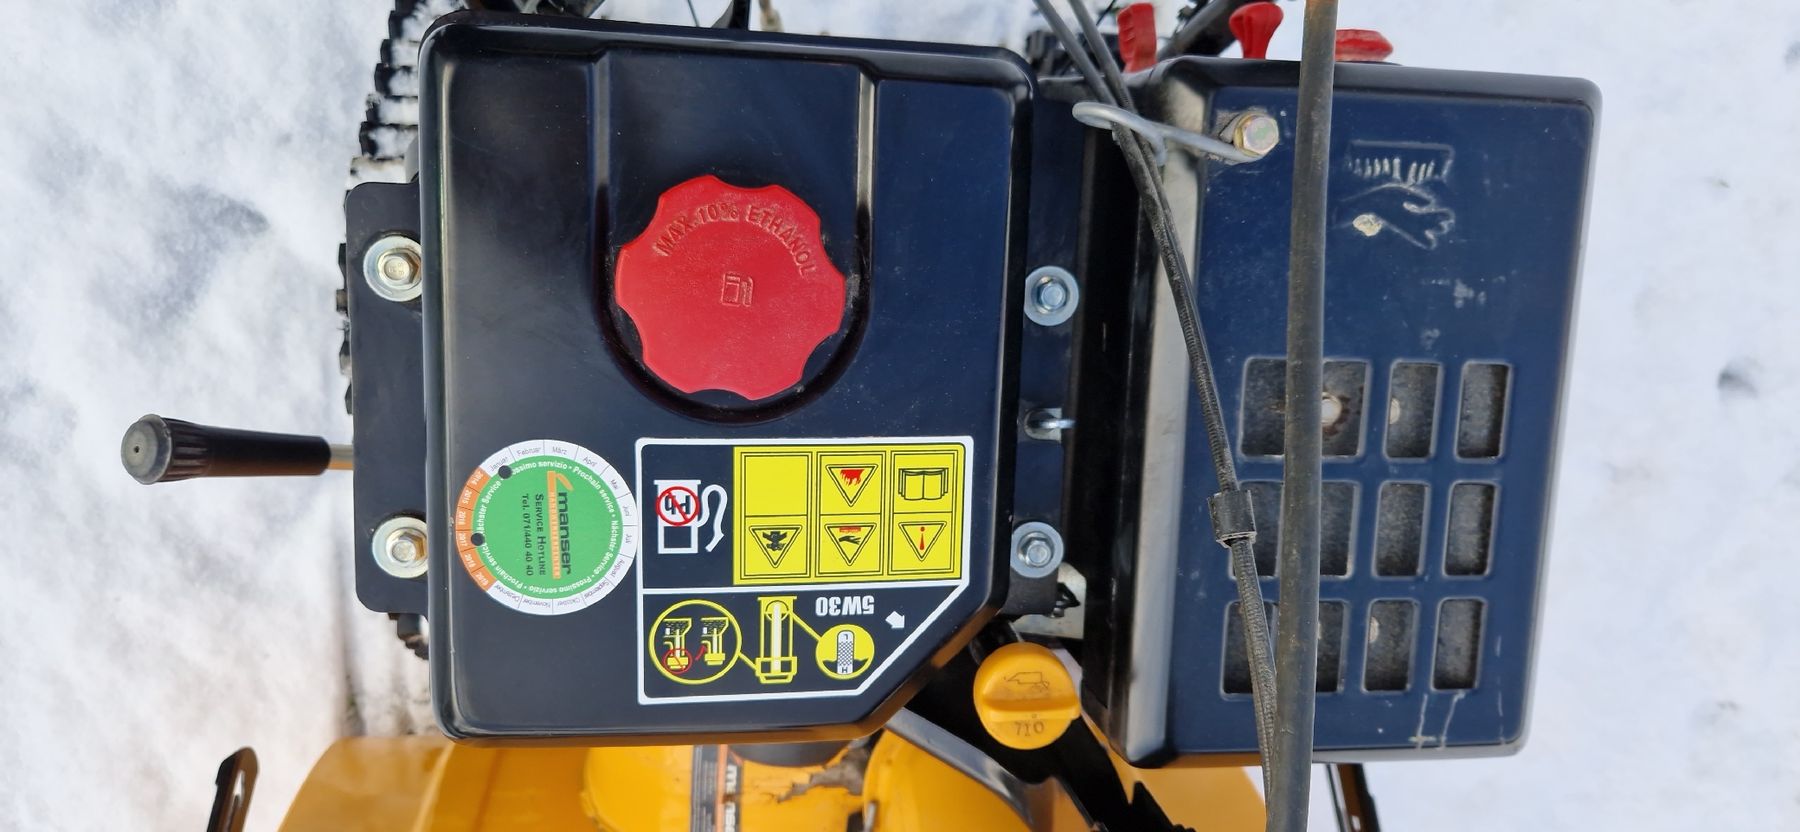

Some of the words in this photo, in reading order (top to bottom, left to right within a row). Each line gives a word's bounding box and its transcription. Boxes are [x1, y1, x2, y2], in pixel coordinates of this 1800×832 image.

[744, 203, 818, 279] ETHANOL
[516, 445, 541, 457] Februar
[551, 445, 568, 455] März
[488, 455, 509, 472] Januar
[537, 459, 568, 470] servizio
[581, 454, 597, 468] April
[469, 469, 484, 486] 2014
[609, 478, 619, 489] Mai
[460, 488, 473, 505] 2015
[480, 477, 502, 505] Service
[571, 463, 603, 491] Prochain
[598, 486, 616, 513] service
[521, 493, 530, 510] Tel.
[621, 504, 631, 517] Juni
[476, 503, 488, 536] ächster
[523, 513, 532, 548] 071/440
[558, 492, 572, 575] manser
[607, 519, 619, 552] Nächster
[624, 533, 632, 544] Juli
[458, 531, 468, 548] 2017
[525, 551, 533, 562] 40
[592, 550, 614, 578] Service
[492, 563, 523, 589] Prochain
[526, 564, 534, 576] 40
[608, 557, 625, 578] August
[493, 582, 520, 602] Dezember
[527, 584, 557, 595] servizio
[558, 573, 592, 596] Prossimo
[582, 578, 609, 601] September
[521, 597, 551, 608] November
[556, 595, 581, 609] Oktober
[815, 595, 875, 617] 5W30
